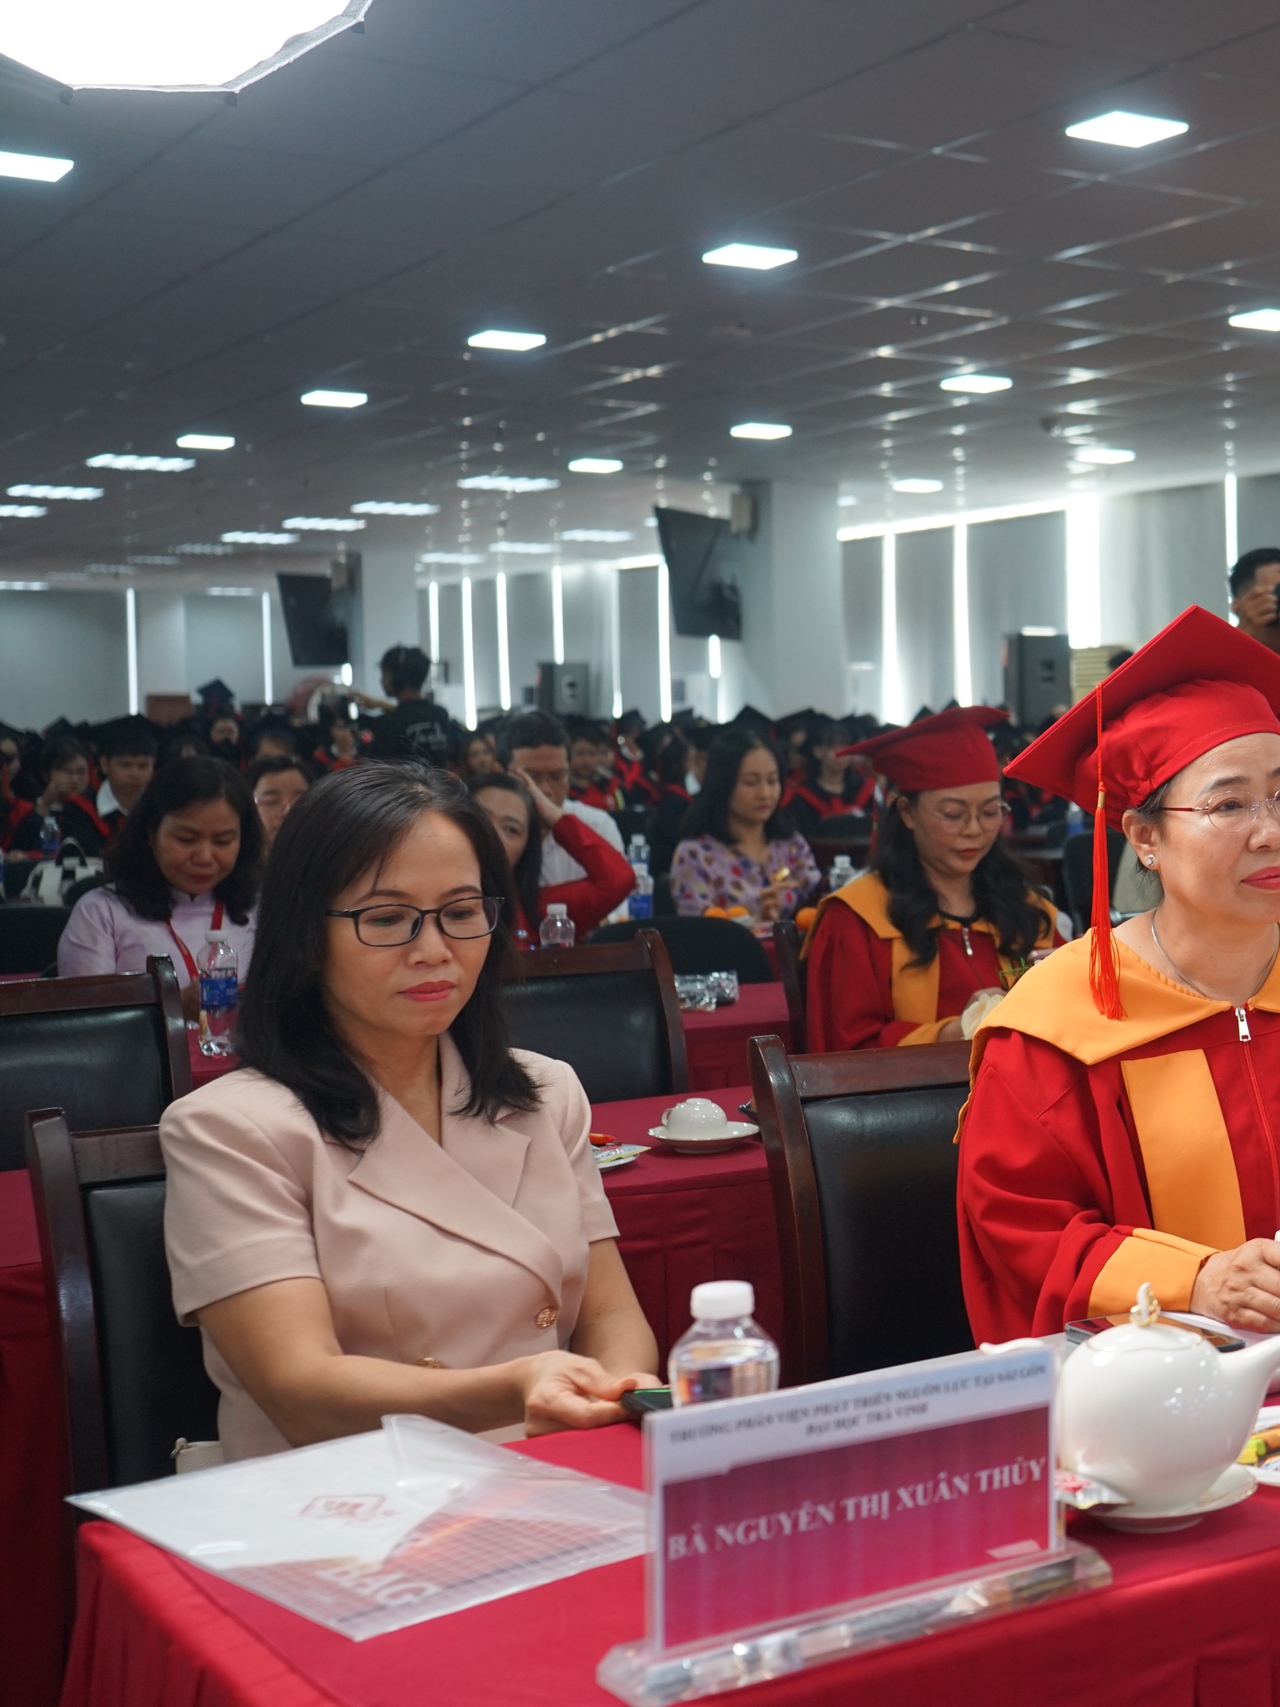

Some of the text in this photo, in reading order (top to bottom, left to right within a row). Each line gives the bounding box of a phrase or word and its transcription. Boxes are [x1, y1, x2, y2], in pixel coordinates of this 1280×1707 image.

[667, 1522, 708, 1561] BÀ
[840, 1489, 891, 1522] THỊ
[896, 1469, 971, 1512] XUÂN
